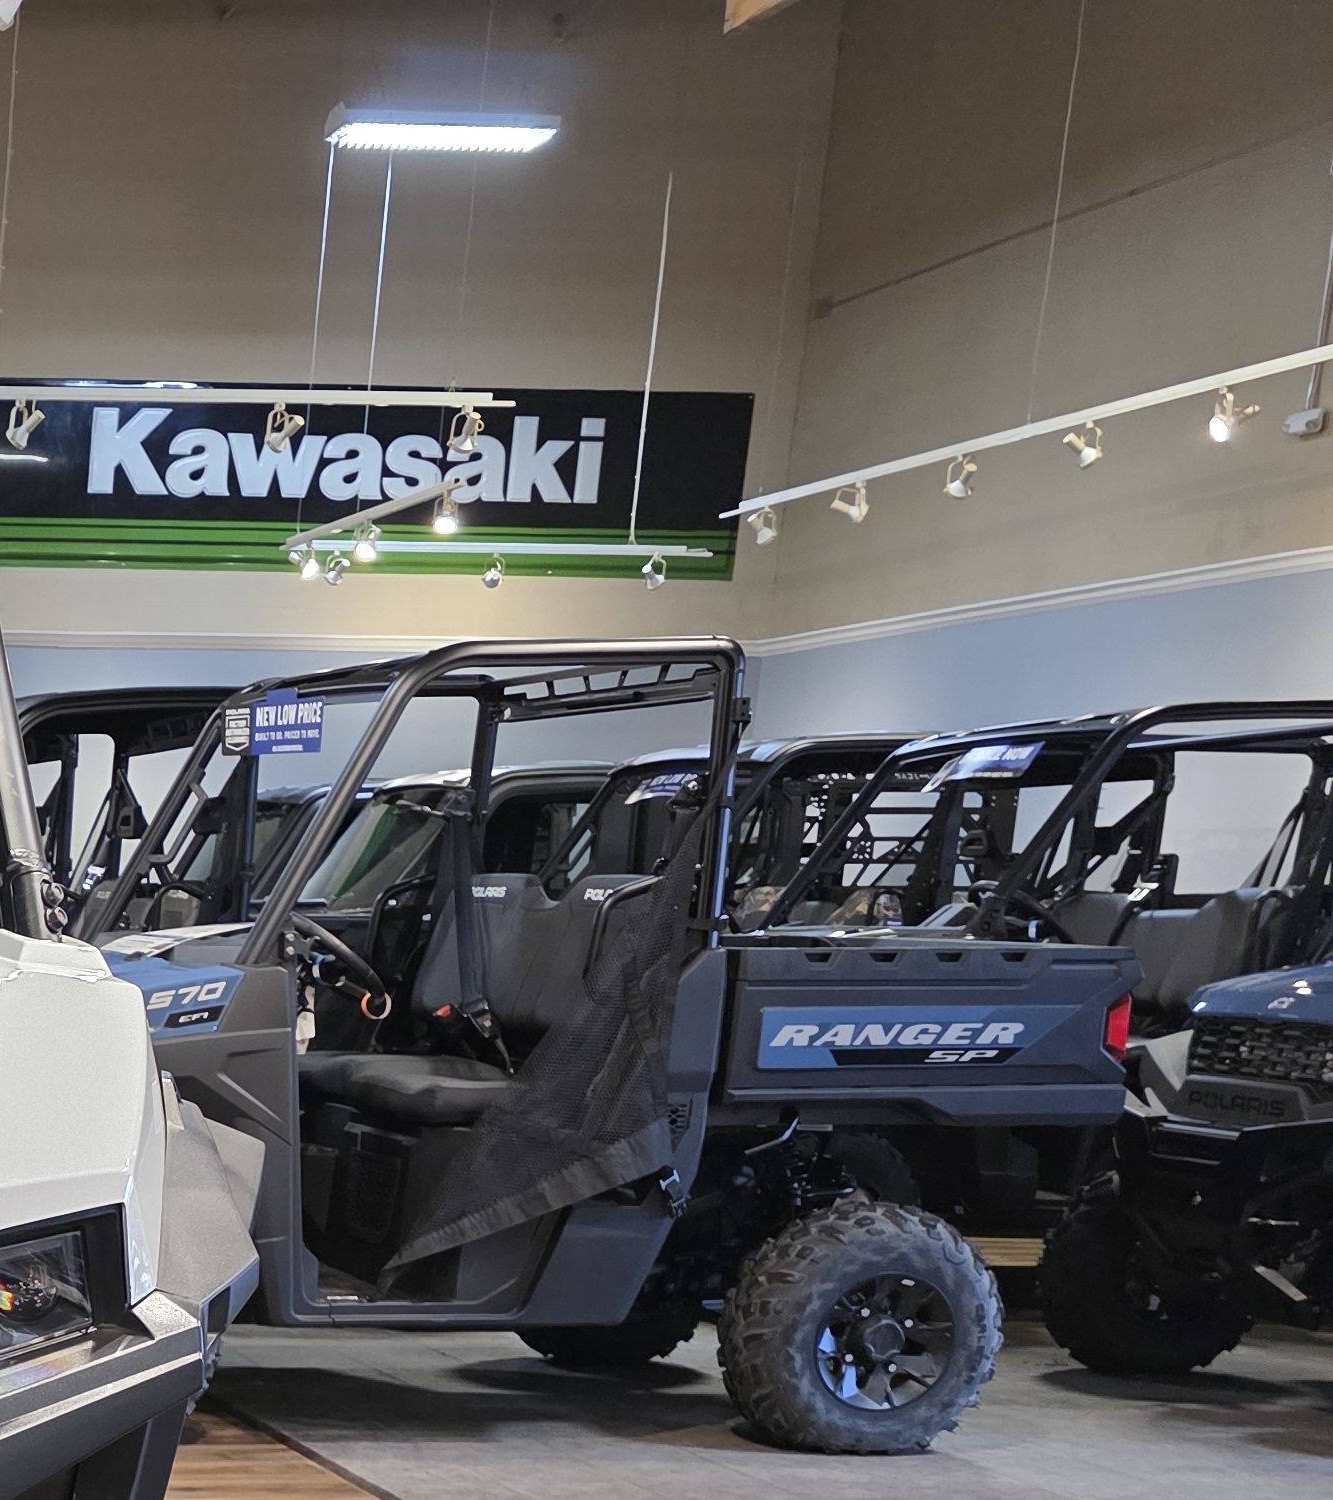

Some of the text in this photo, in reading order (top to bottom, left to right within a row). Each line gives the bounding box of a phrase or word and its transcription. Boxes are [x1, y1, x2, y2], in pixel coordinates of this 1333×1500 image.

[86, 406, 607, 504] Kawasaki
[255, 701, 323, 727] NEW LOW PRICE
[146, 981, 227, 1010] 570
[768, 1022, 1025, 1047] RANGER
[923, 1049, 1000, 1063] SP
